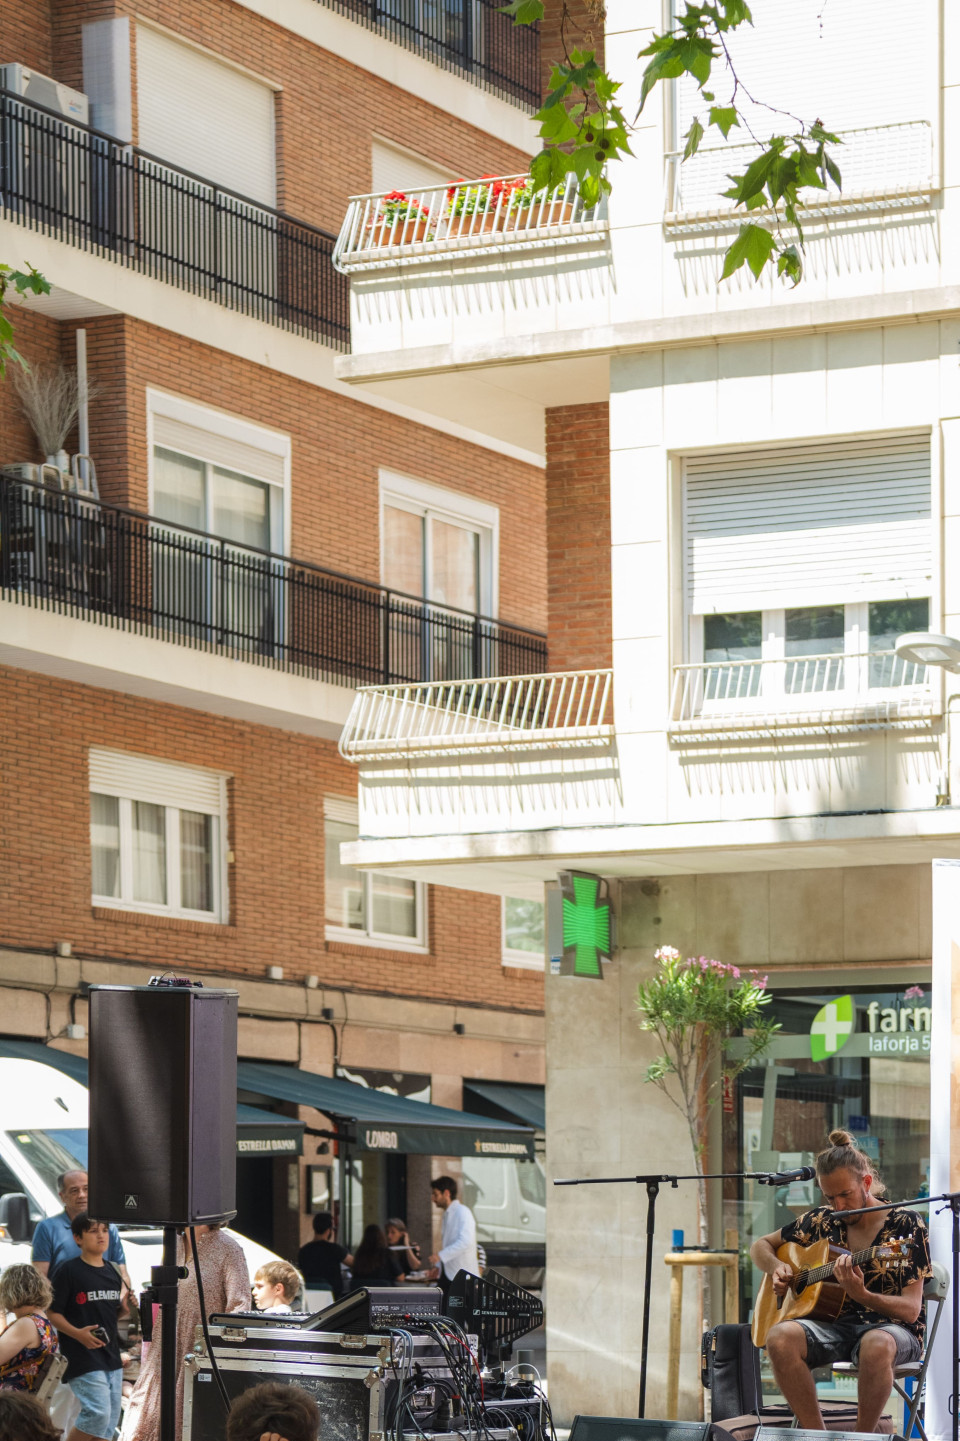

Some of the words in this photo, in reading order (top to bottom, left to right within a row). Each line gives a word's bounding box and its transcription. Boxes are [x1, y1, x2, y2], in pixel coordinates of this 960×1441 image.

[869, 1035, 919, 1054] laforja
[238, 1140, 271, 1152] ESTRELLA
[271, 1139, 297, 1150] DAMM
[366, 1130, 398, 1149] LOMBO
